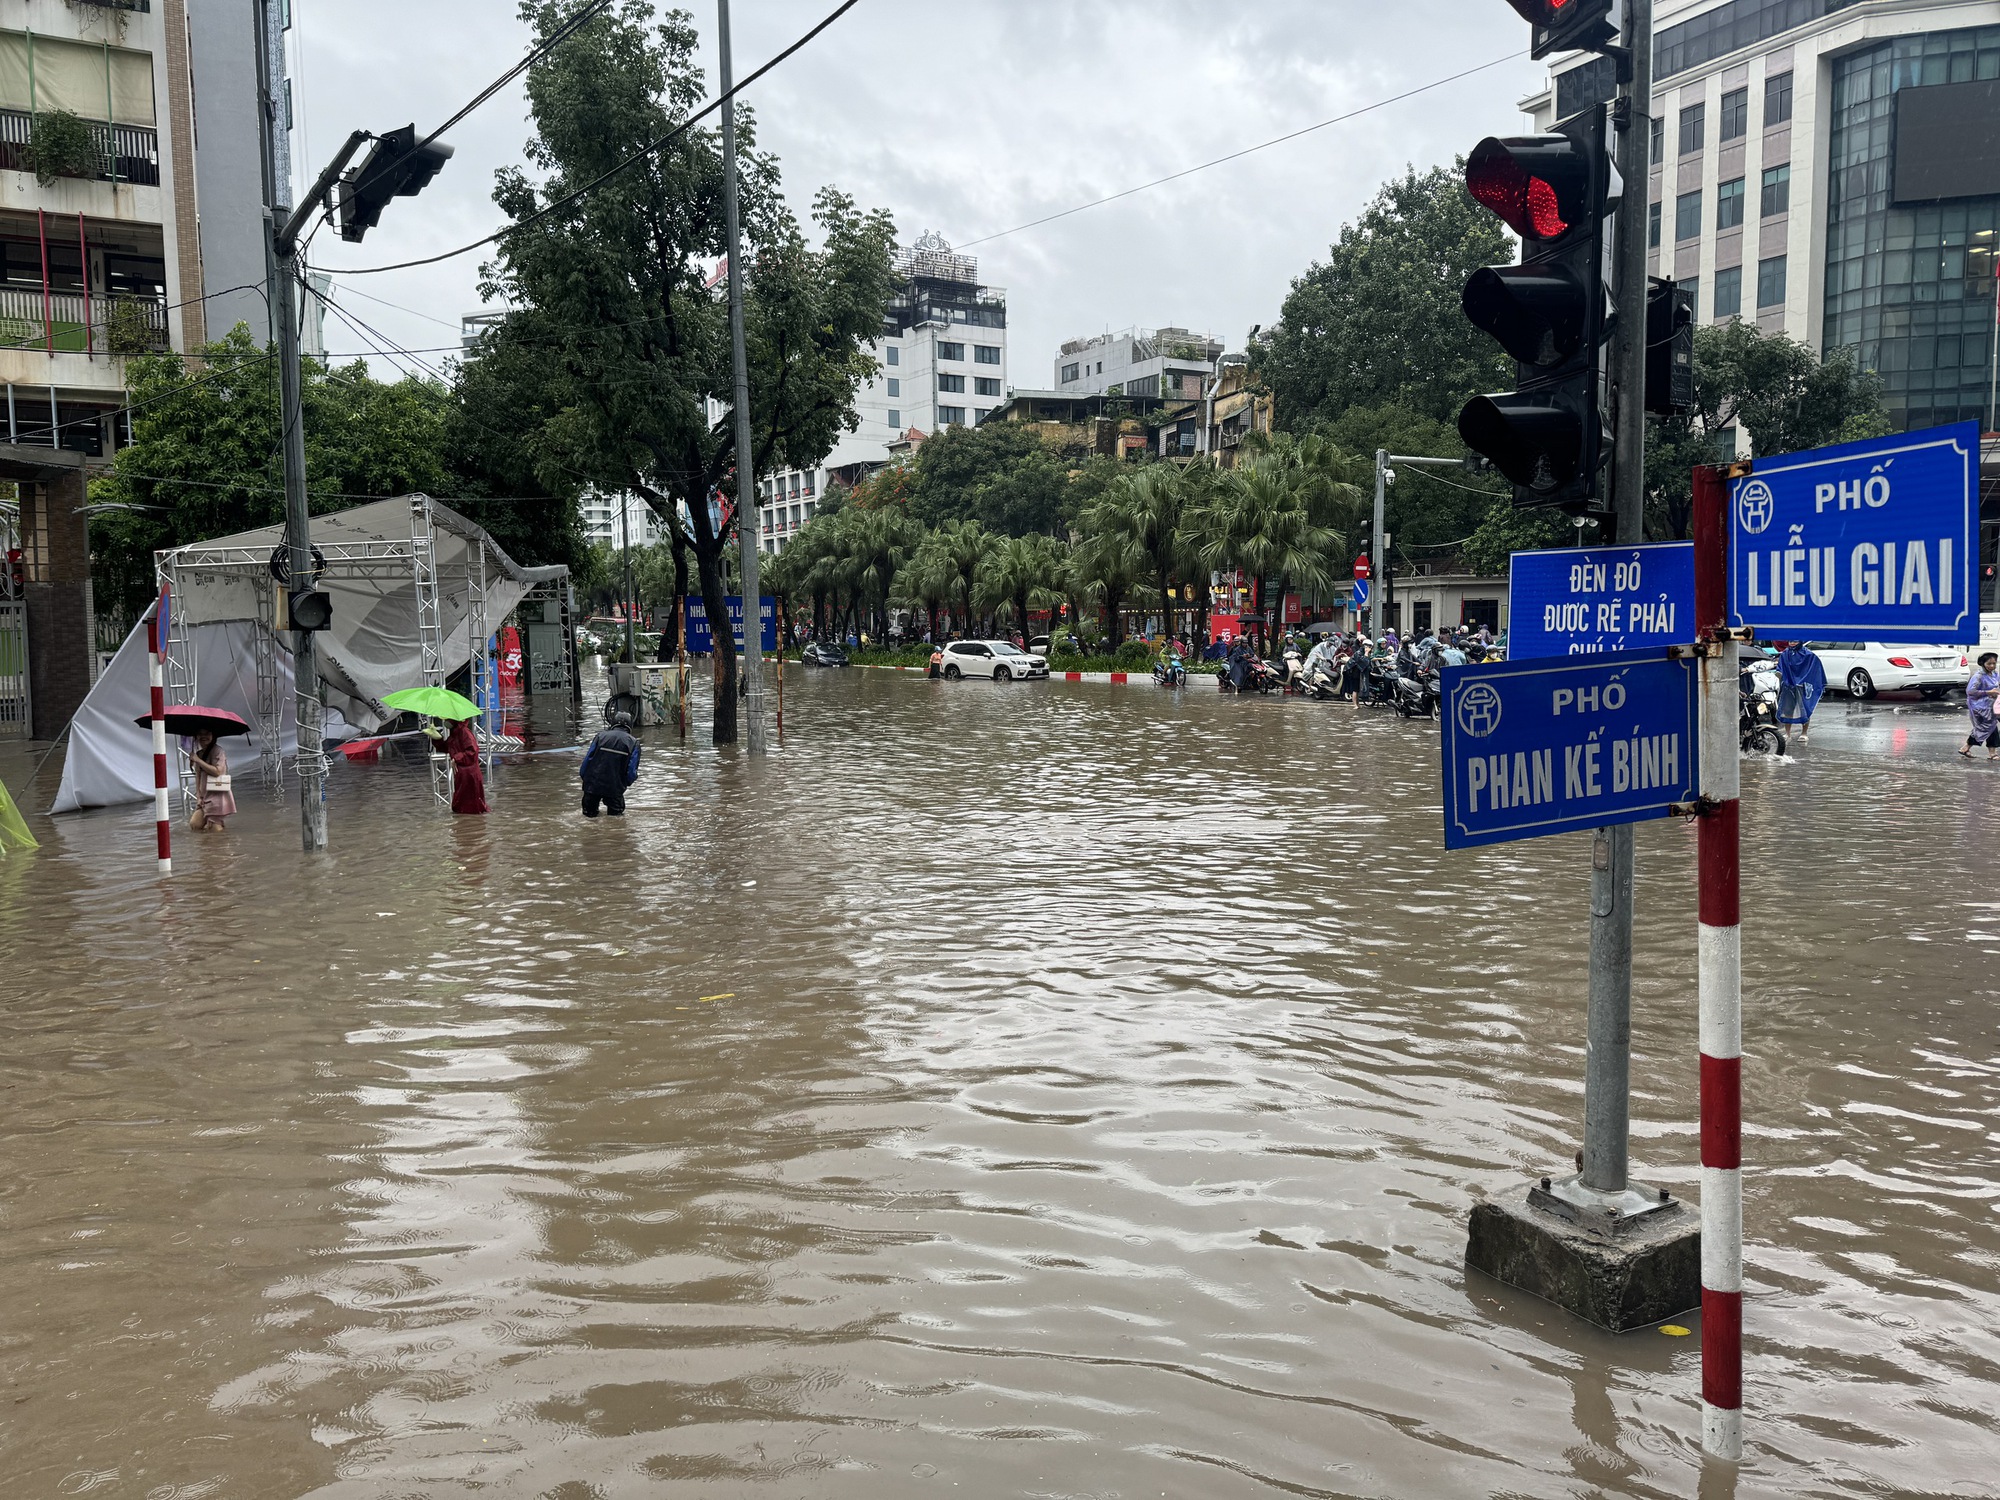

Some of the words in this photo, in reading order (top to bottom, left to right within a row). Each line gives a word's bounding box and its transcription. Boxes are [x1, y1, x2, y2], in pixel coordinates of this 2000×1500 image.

[1815, 458, 1895, 513] PHỐ
[1569, 556, 1607, 593] ĐÈN
[1613, 551, 1642, 592] ĐỎ
[1748, 523, 1836, 607] LIỄU
[1851, 538, 1953, 606] GIAI
[1543, 602, 1590, 638] ĐƯỢC
[1597, 598, 1622, 633] RẼ
[1629, 593, 1675, 633] PHẢI
[1552, 668, 1630, 716] PHỐ
[1468, 748, 1553, 813] PHAN
[1564, 726, 1605, 800] KẾ
[1612, 725, 1679, 793] BÍNH
